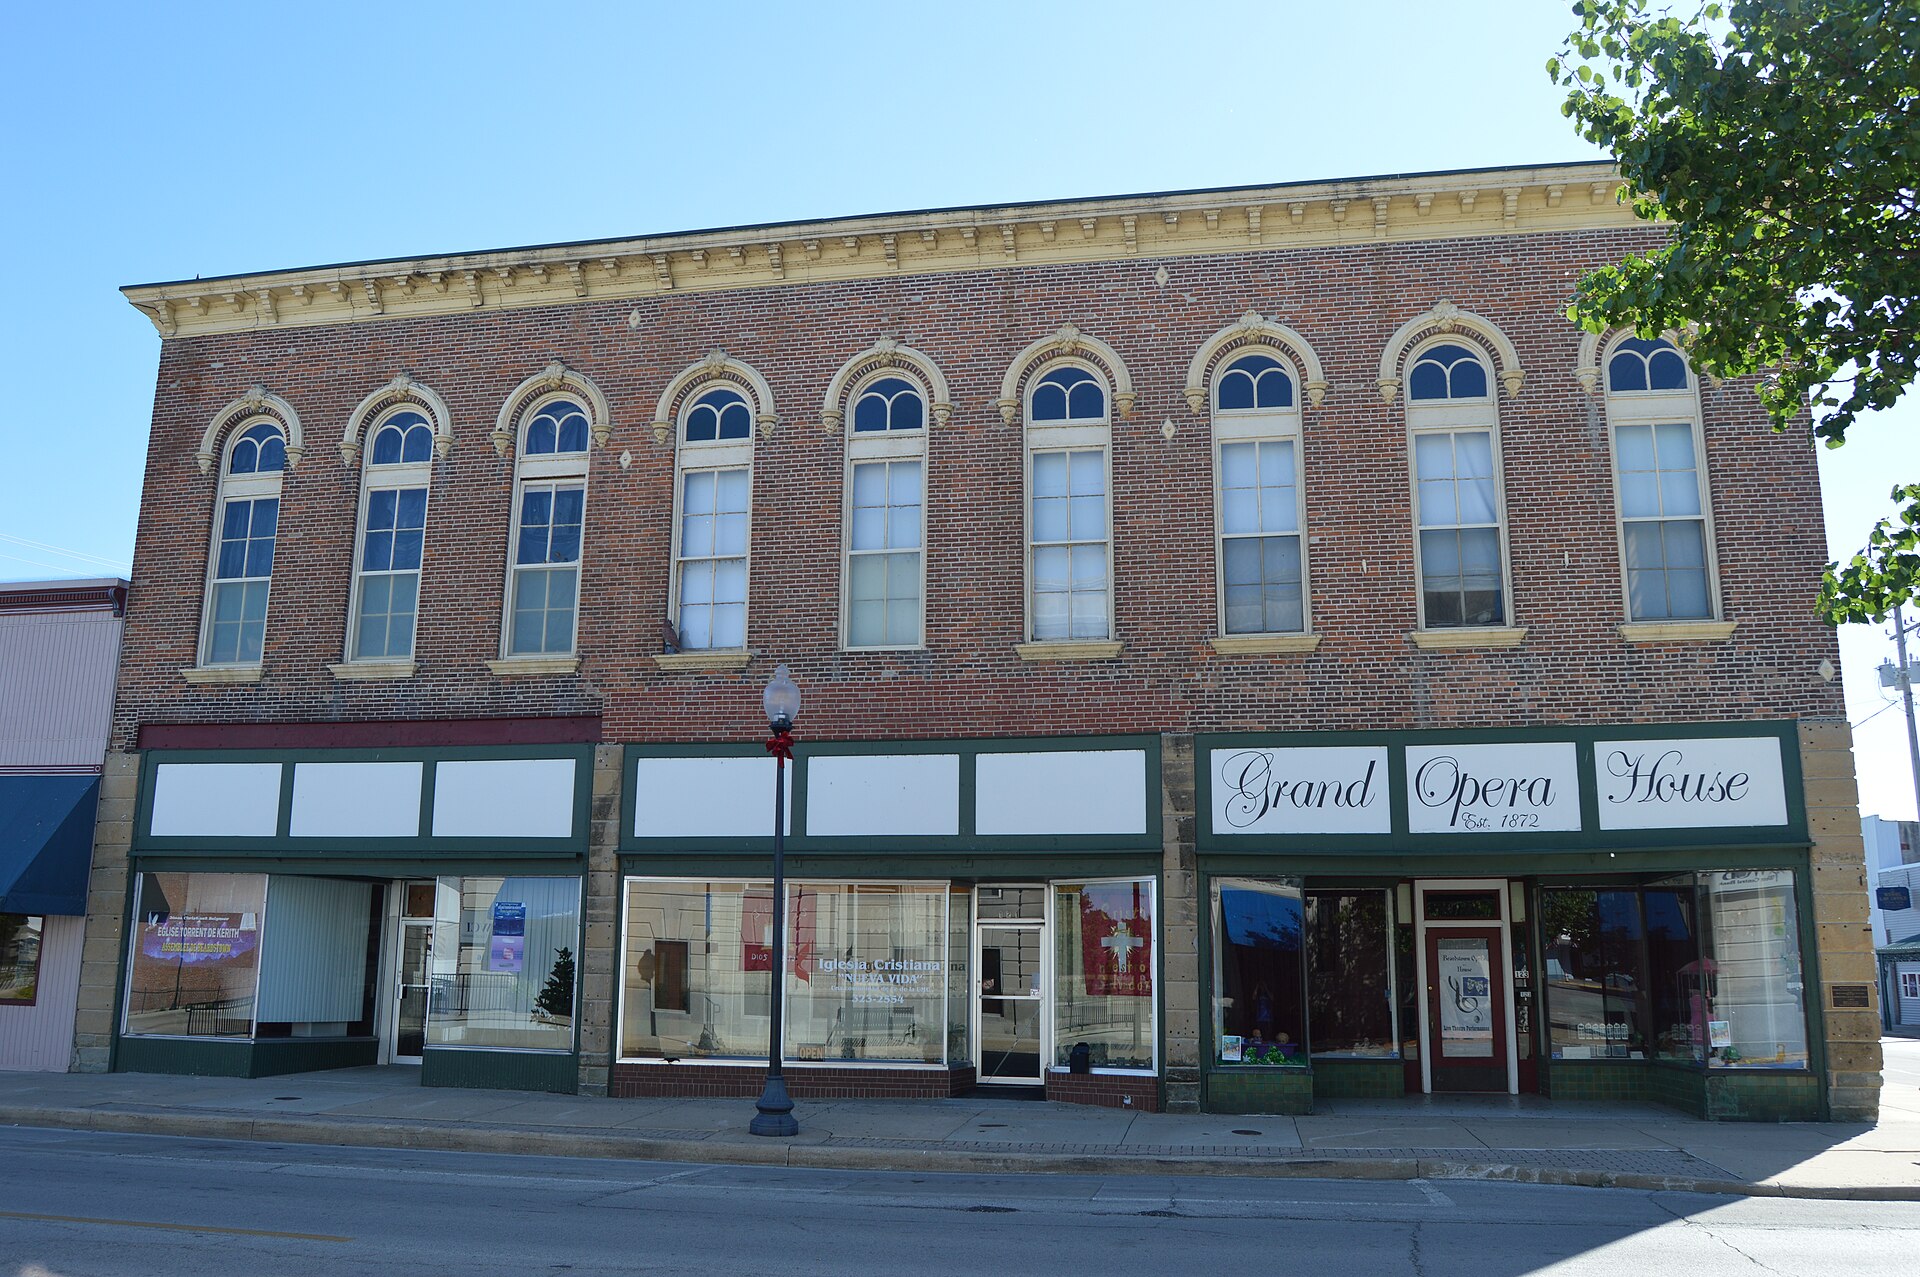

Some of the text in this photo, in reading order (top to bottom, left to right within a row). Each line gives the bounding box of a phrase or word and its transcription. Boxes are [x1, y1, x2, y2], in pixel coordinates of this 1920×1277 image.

[1222, 750, 1749, 827] Grand Opera House
[1461, 811, 1540, 830] Est. 1872
[158, 927, 240, 938] EGLISE TORRENT DE KERITH
[751, 954, 769, 962] DIOS
[819, 958, 867, 972] Iglesia
[874, 958, 940, 971] Cristiana
[800, 1047, 823, 1059] OPEN
